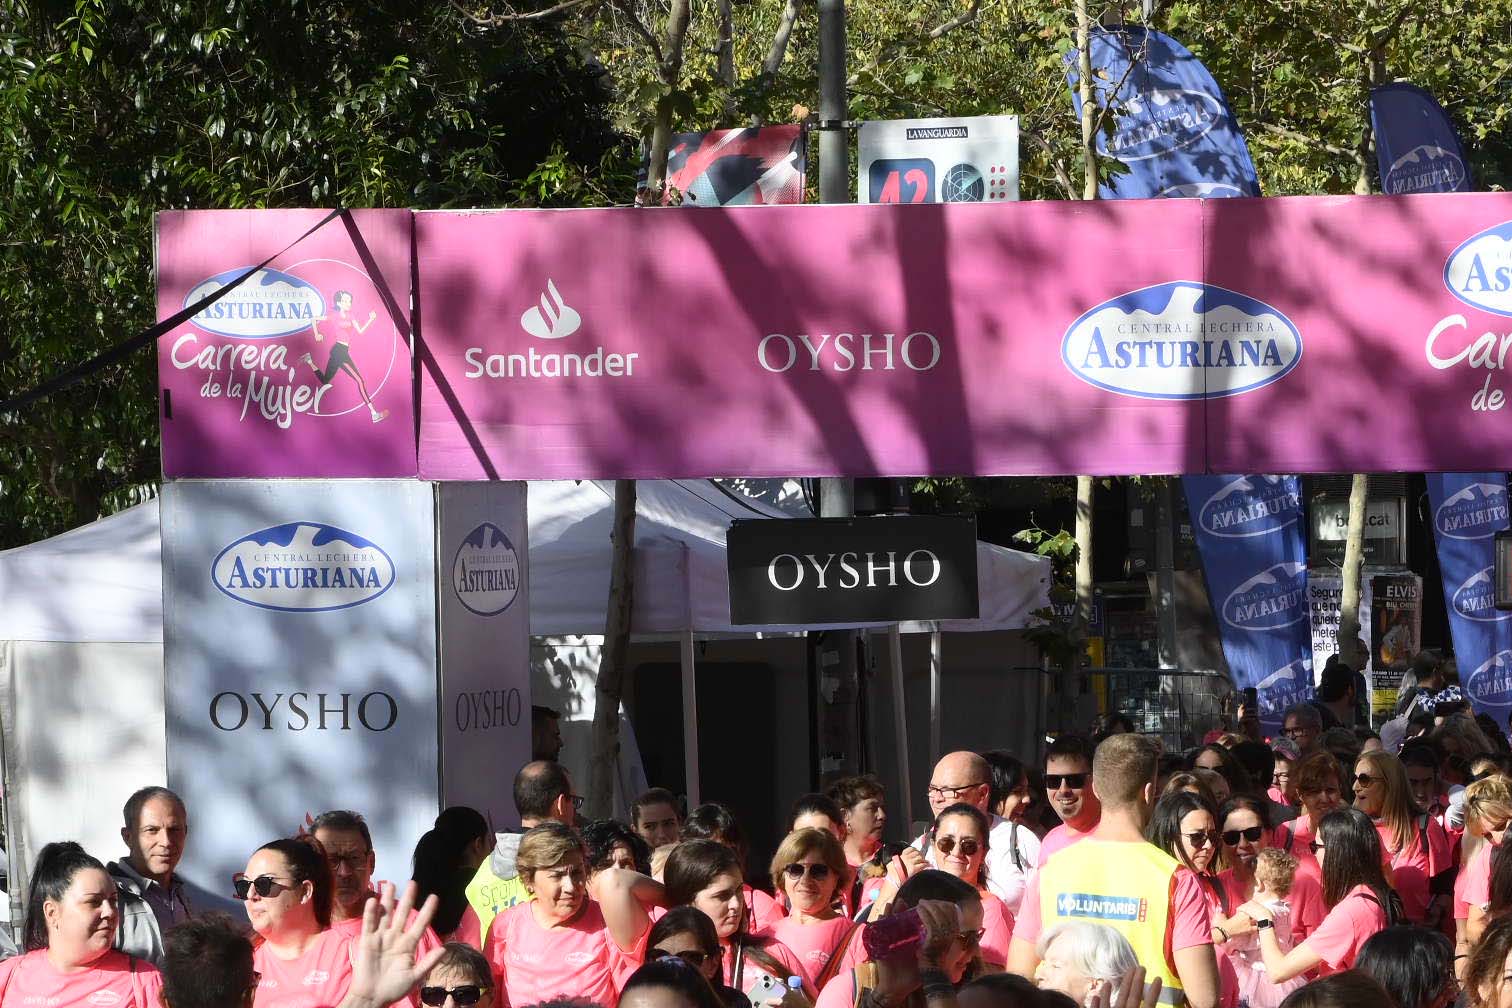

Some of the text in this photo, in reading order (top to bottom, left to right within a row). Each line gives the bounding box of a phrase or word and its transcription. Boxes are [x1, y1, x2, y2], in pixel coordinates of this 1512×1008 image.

[1117, 322, 1275, 334] CENTRAL LECHERA
[171, 333, 288, 370] Carrera
[464, 347, 638, 379] Santander
[757, 332, 940, 373] OYSHO
[1081, 326, 1284, 369] ASTURIANA
[200, 365, 333, 429] de la Mujer
[1471, 373, 1505, 412] de
[226, 556, 382, 589] ASTURIANA
[254, 553, 375, 562] CENTRAL LECHERA
[458, 558, 516, 593] ASTURIANA
[768, 550, 941, 591] OYSHO
[1386, 585, 1417, 597] ELVIS
[1313, 613, 1341, 627] quiere
[209, 691, 398, 731] OYSHO
[455, 687, 521, 731] OYSHO
